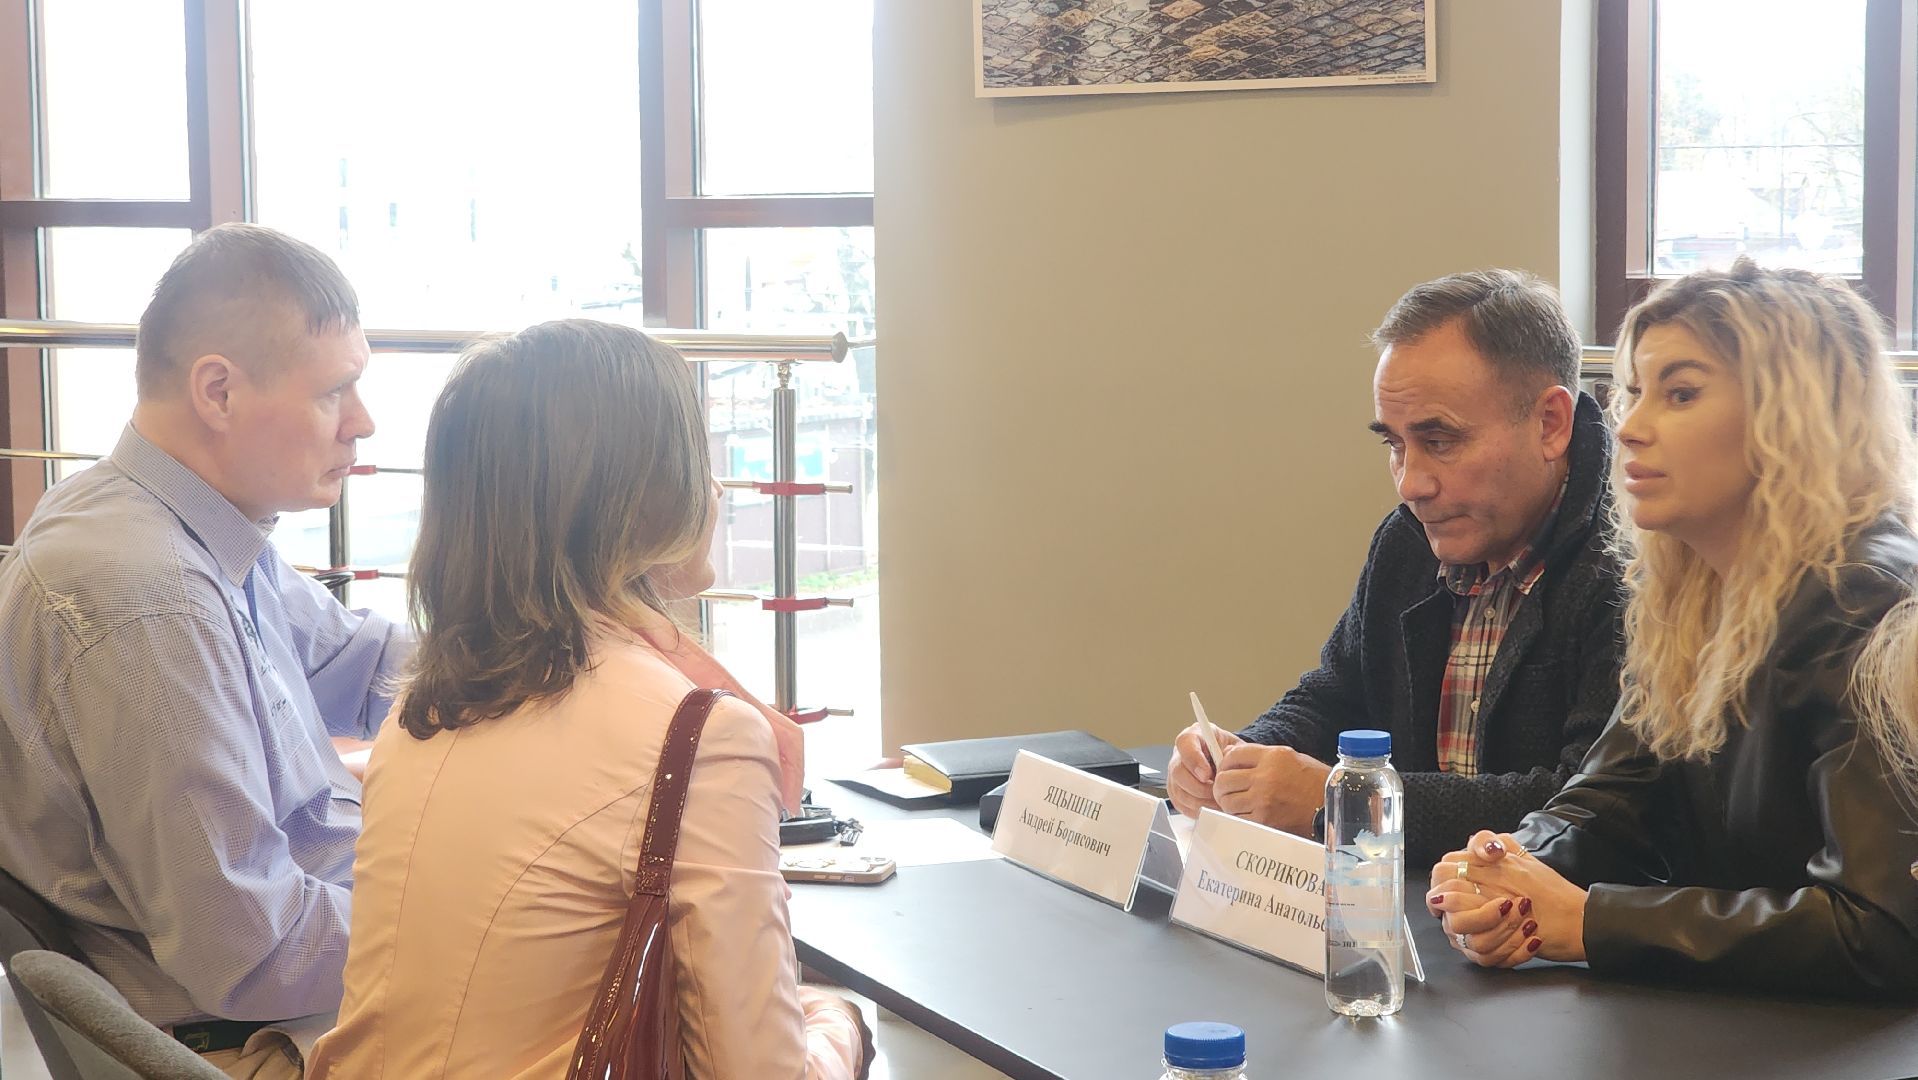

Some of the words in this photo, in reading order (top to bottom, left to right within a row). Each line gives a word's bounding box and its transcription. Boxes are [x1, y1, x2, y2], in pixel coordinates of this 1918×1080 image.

[1043, 785, 1103, 821] ЯЦЫШИН
[1019, 807, 1056, 834] Андрей
[1054, 820, 1112, 857] Борисович
[1197, 869, 1262, 906] Екатерина
[1235, 850, 1326, 897] СКОРИКОВА
